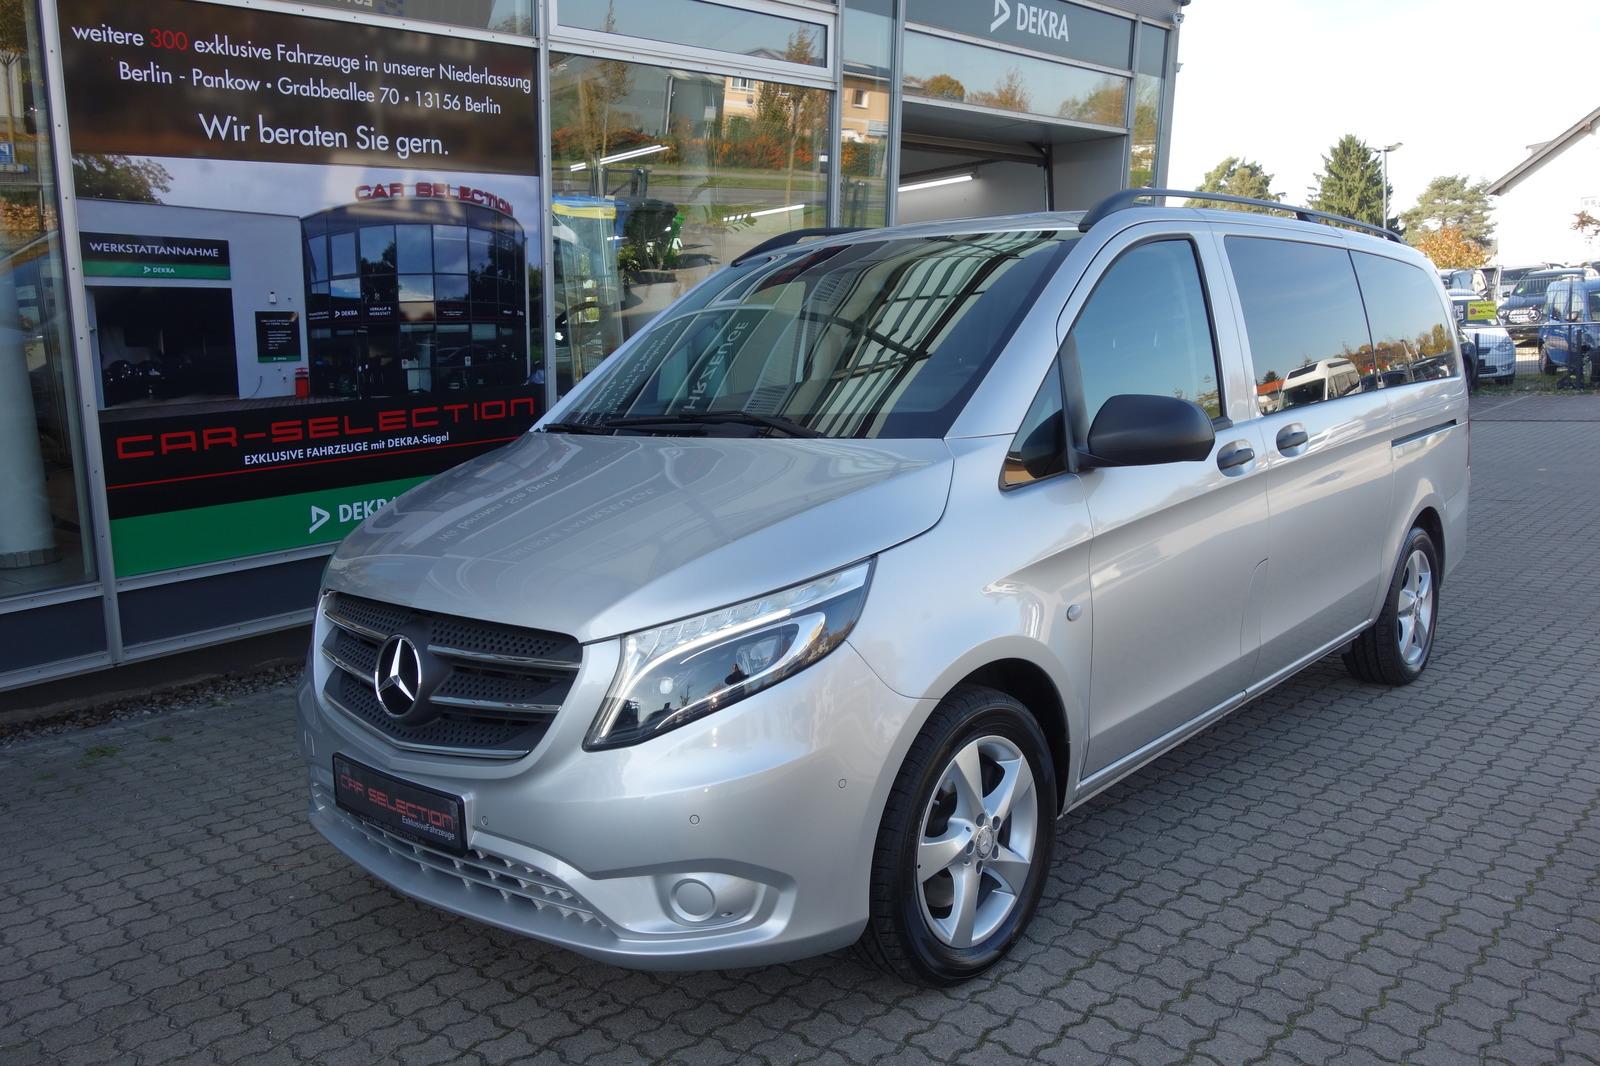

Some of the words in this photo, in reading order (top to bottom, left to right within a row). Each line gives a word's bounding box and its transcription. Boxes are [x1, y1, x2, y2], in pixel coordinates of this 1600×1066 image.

[1016, 3, 1070, 42] DEKRA
[72, 24, 144, 46] weitere
[150, 29, 188, 51] 300
[194, 34, 272, 60] exklusive
[277, 43, 360, 74] Fahrzeuge
[365, 54, 378, 73] in
[383, 62, 435, 79] unserer
[439, 64, 531, 94] Niederlassung
[119, 61, 172, 84] Berlin
[192, 68, 260, 91] Pankow
[277, 77, 375, 103] Grabbeallee
[379, 87, 399, 105] 70
[415, 91, 461, 111] 13156
[465, 95, 501, 115] Berlin
[199, 113, 249, 142] Wir
[258, 114, 348, 148] beraten
[356, 125, 389, 151] Sie
[396, 135, 449, 159] gern.
[355, 183, 404, 201] CAR
[89, 242, 219, 257] WERKSTATTANNAHME
[116, 398, 535, 459] CAR-SELECTION
[244, 449, 304, 465] EXKLUSIVE
[306, 441, 369, 459] FAHRZEUGE
[370, 439, 385, 451] mit
[387, 432, 450, 449] DEKRA-Siegel
[338, 496, 396, 523] DEK
[340, 773, 365, 797] CAR
[367, 787, 454, 832] SELECTION
